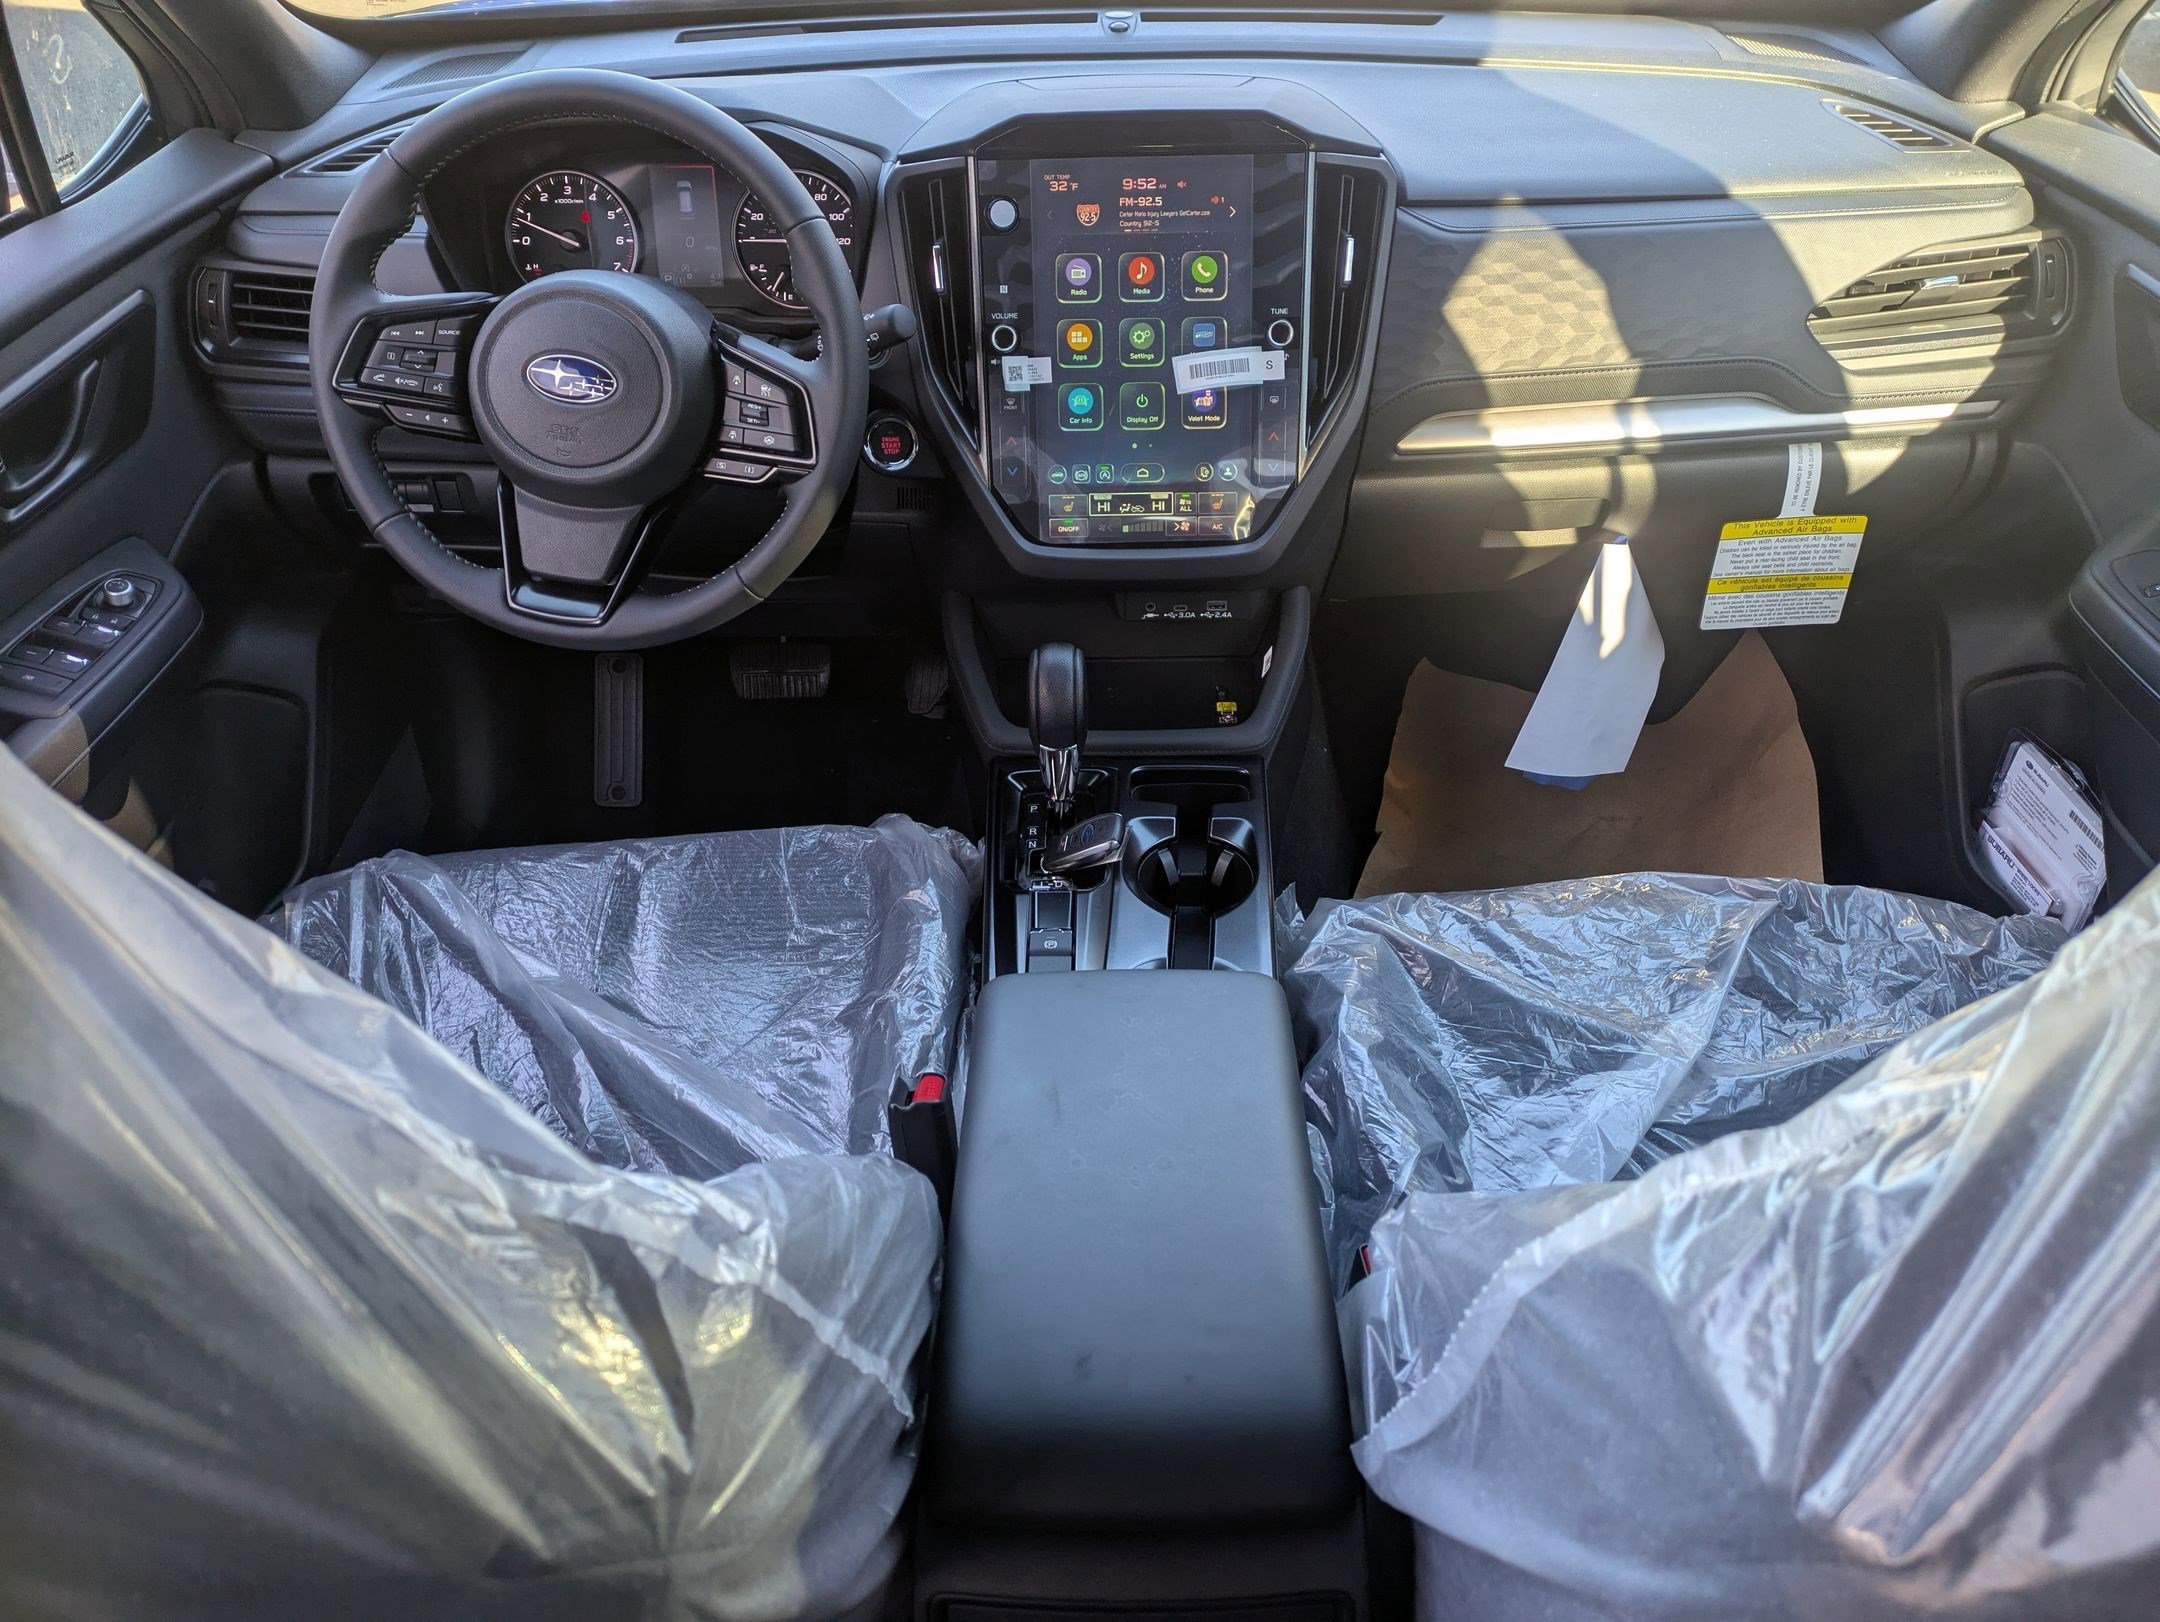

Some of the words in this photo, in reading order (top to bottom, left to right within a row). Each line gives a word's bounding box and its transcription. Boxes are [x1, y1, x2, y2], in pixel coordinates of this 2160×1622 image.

[1050, 181, 1068, 191] 32
[1122, 178, 1157, 190] 9:52
[563, 186, 572, 195] 3
[540, 193, 548, 202] 2
[588, 193, 597, 201] 4
[1120, 197, 1162, 206] FM-92.5
[526, 212, 531, 222] 1
[607, 211, 615, 220] 5
[751, 213, 763, 221] 20
[1120, 220, 1141, 228] Country
[522, 237, 530, 245] 0
[616, 237, 624, 245] 6
[614, 262, 621, 271] 7
[1072, 354, 1087, 362] Apps
[1266, 360, 1273, 369] S
[1127, 416, 1148, 424] Display
[1097, 502, 1110, 512] HI
[1152, 501, 1165, 511] HI
[1754, 520, 1784, 528] Vehicle
[1797, 517, 1836, 526] Equipped
[1840, 516, 1857, 524] with
[1752, 527, 1794, 536] Advanced
[1811, 525, 1832, 533] Bags
[1774, 536, 1809, 544] Advanced
[1741, 584, 1776, 592] gonflables
[1030, 805, 1038, 813] P
[1987, 834, 2015, 868] SUBARU
